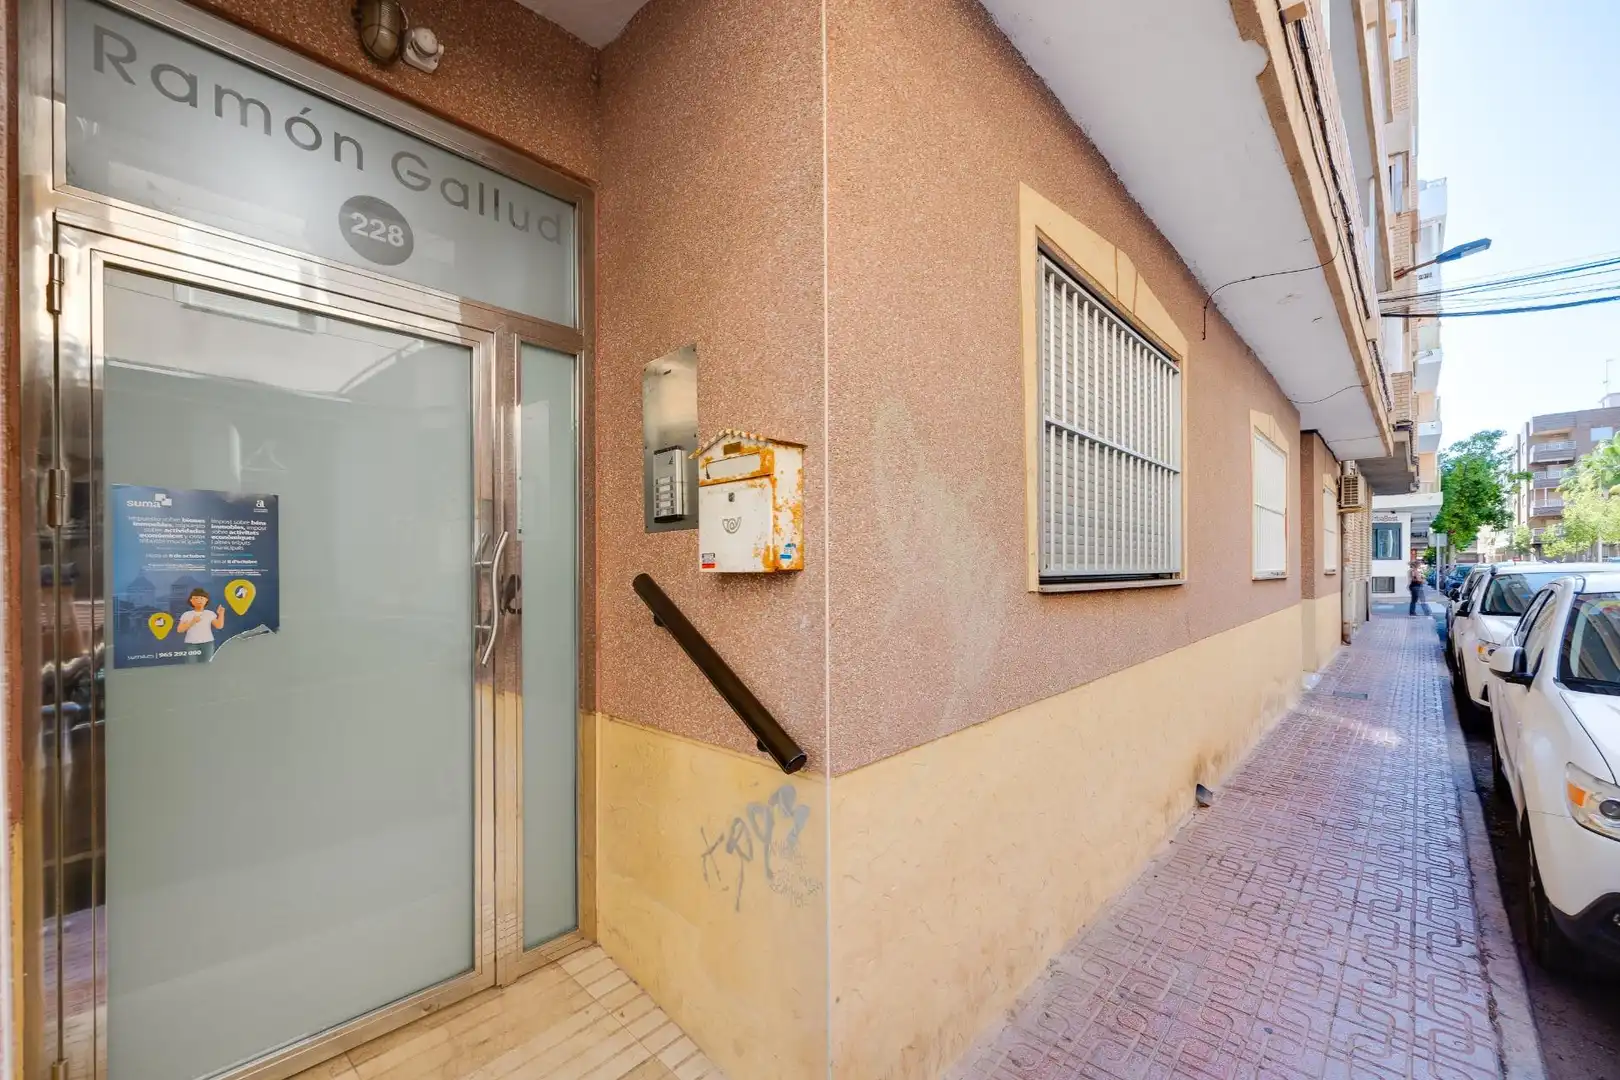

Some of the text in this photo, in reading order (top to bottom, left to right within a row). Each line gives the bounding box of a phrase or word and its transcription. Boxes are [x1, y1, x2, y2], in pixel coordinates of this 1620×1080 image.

[92, 24, 563, 246] Ramón Gallud
[350, 210, 406, 249] 228
[126, 500, 161, 508] suma
